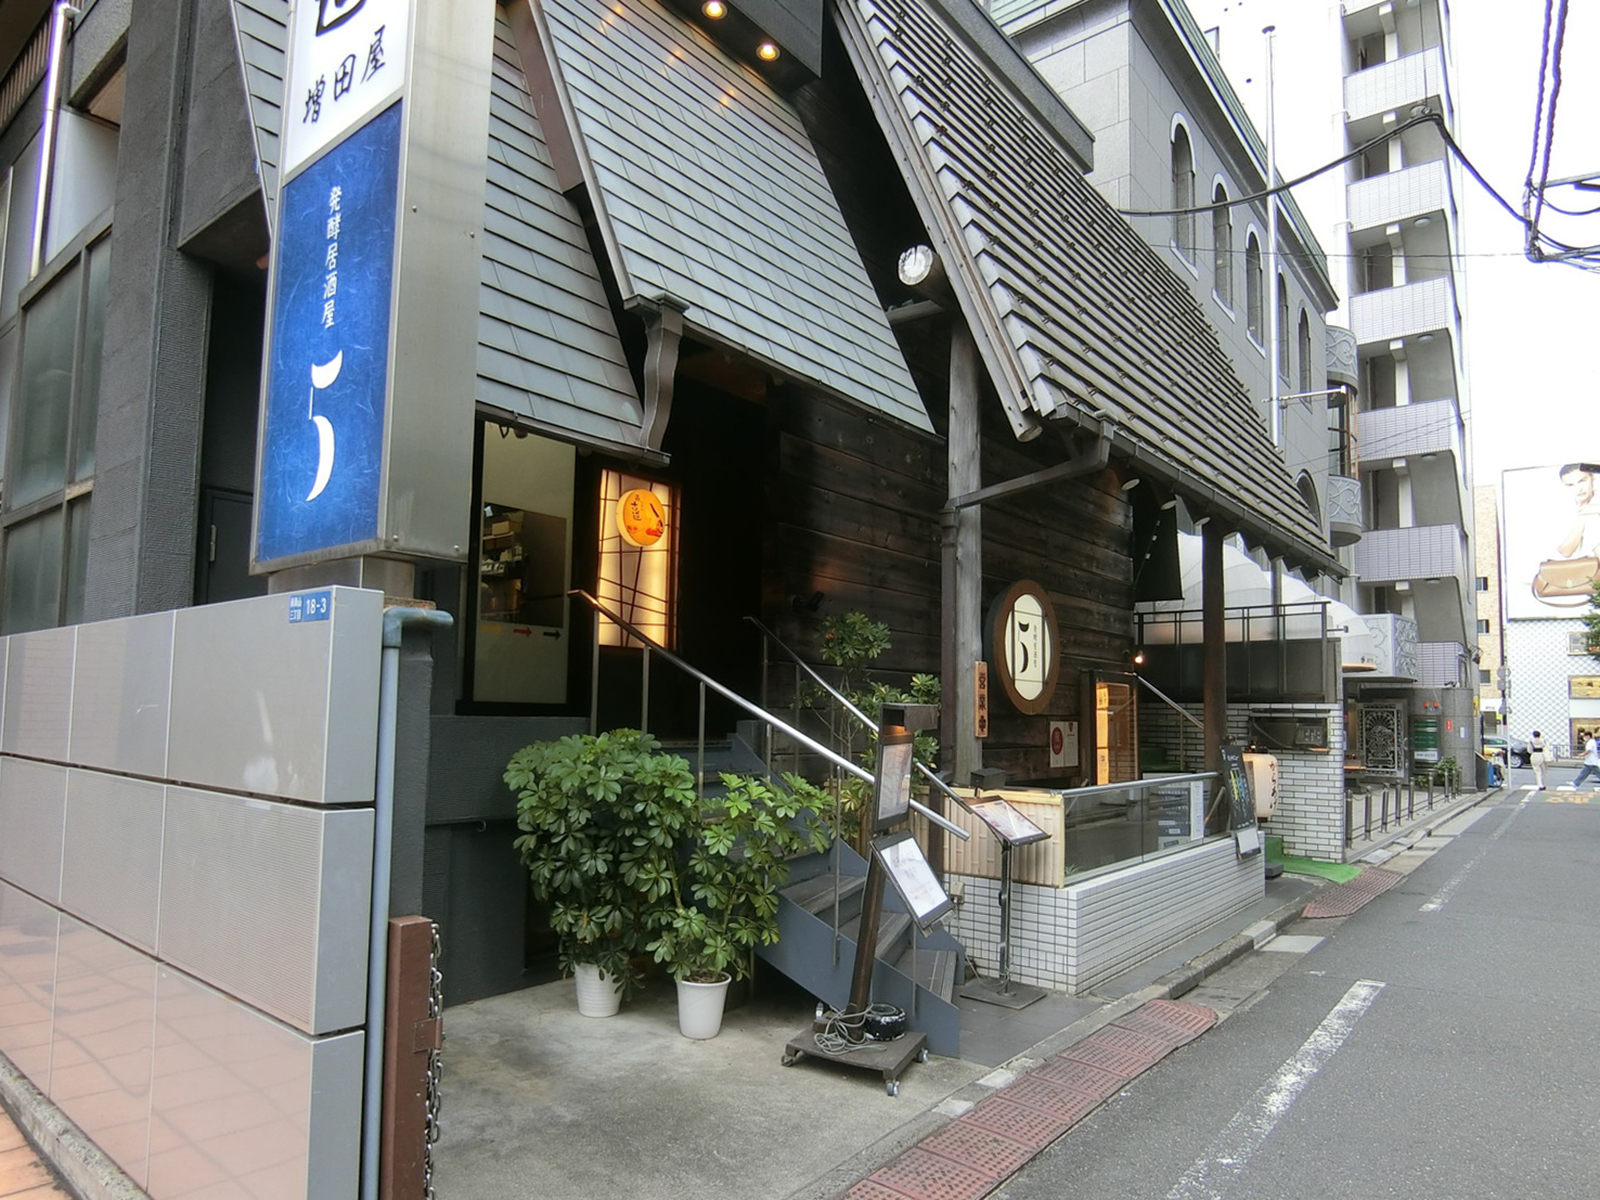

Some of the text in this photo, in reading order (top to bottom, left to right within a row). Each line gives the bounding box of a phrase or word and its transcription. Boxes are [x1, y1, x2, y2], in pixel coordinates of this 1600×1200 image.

[302, 24, 386, 124] 増田屋
[321, 185, 342, 329] 発酵居酒屋
[306, 597, 327, 615] 18-3
[978, 672, 987, 733] 営業中
